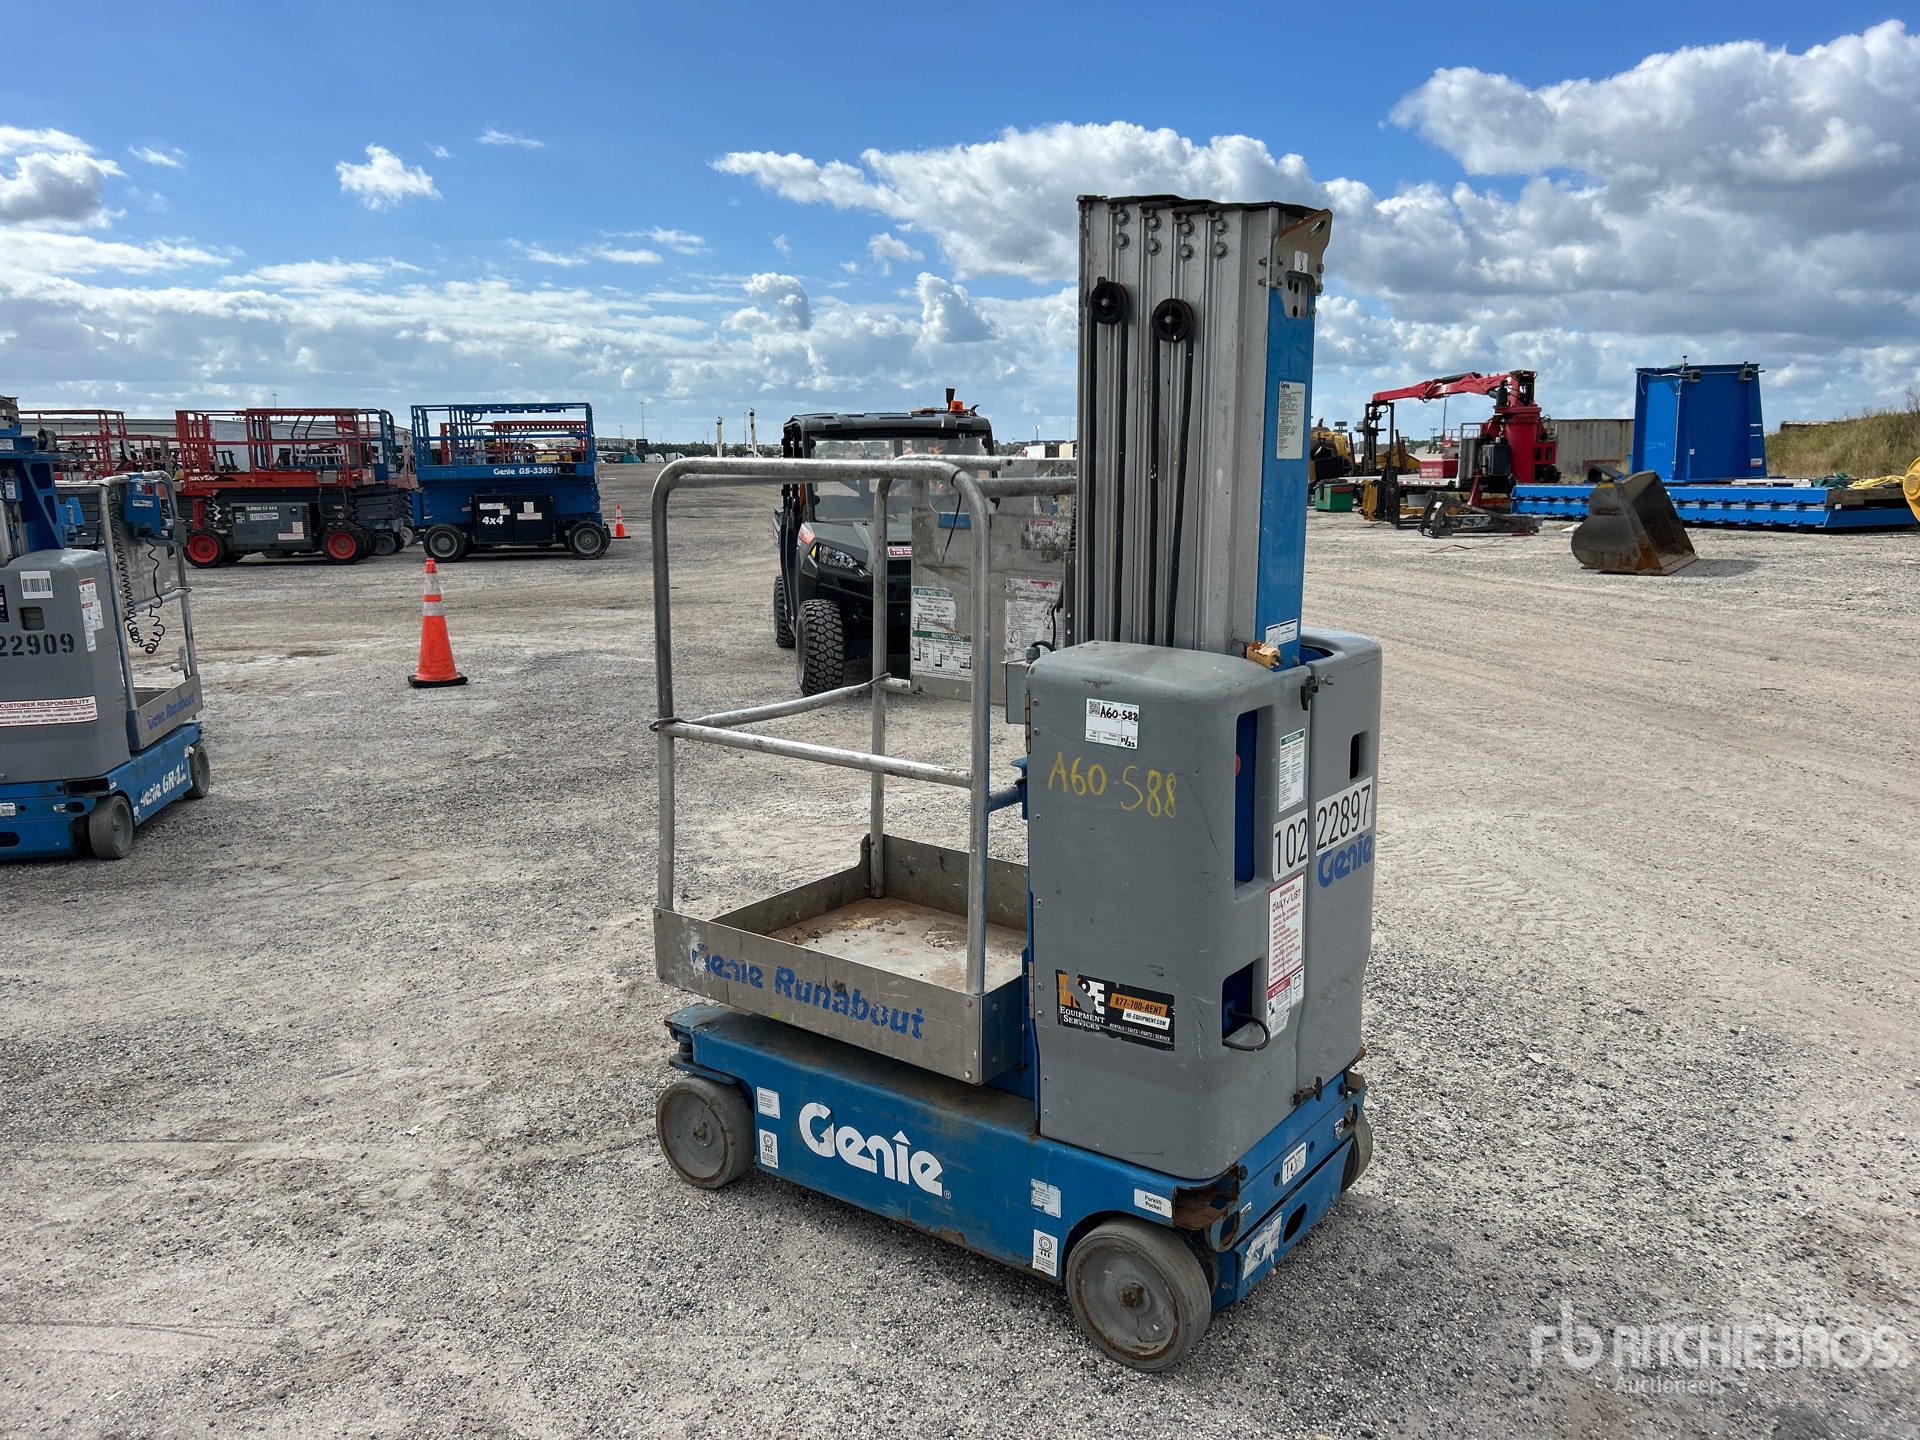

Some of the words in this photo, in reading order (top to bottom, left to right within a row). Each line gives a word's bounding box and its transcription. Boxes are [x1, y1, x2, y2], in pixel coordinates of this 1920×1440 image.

[482, 516, 504, 524] 4x4
[0, 633, 75, 656] 22909
[166, 692, 194, 719] Runabout
[1100, 705, 1138, 721] A60-588
[1316, 784, 1370, 850] 22897
[1274, 818, 1308, 874] 102
[1318, 832, 1373, 888] Genie
[1272, 896, 1285, 912] DAILY
[1290, 888, 1300, 901] LIST
[692, 944, 764, 990] Genie
[774, 966, 924, 1040] Runabout
[1060, 1006, 1106, 1024] EQUIPMENT
[1114, 996, 1162, 1015] 877-700-RENT
[1063, 1014, 1100, 1030] SERVICES
[1141, 1029, 1153, 1038] PARTS
[799, 1102, 943, 1196] Genie
[1145, 1200, 1162, 1212] Pocket
